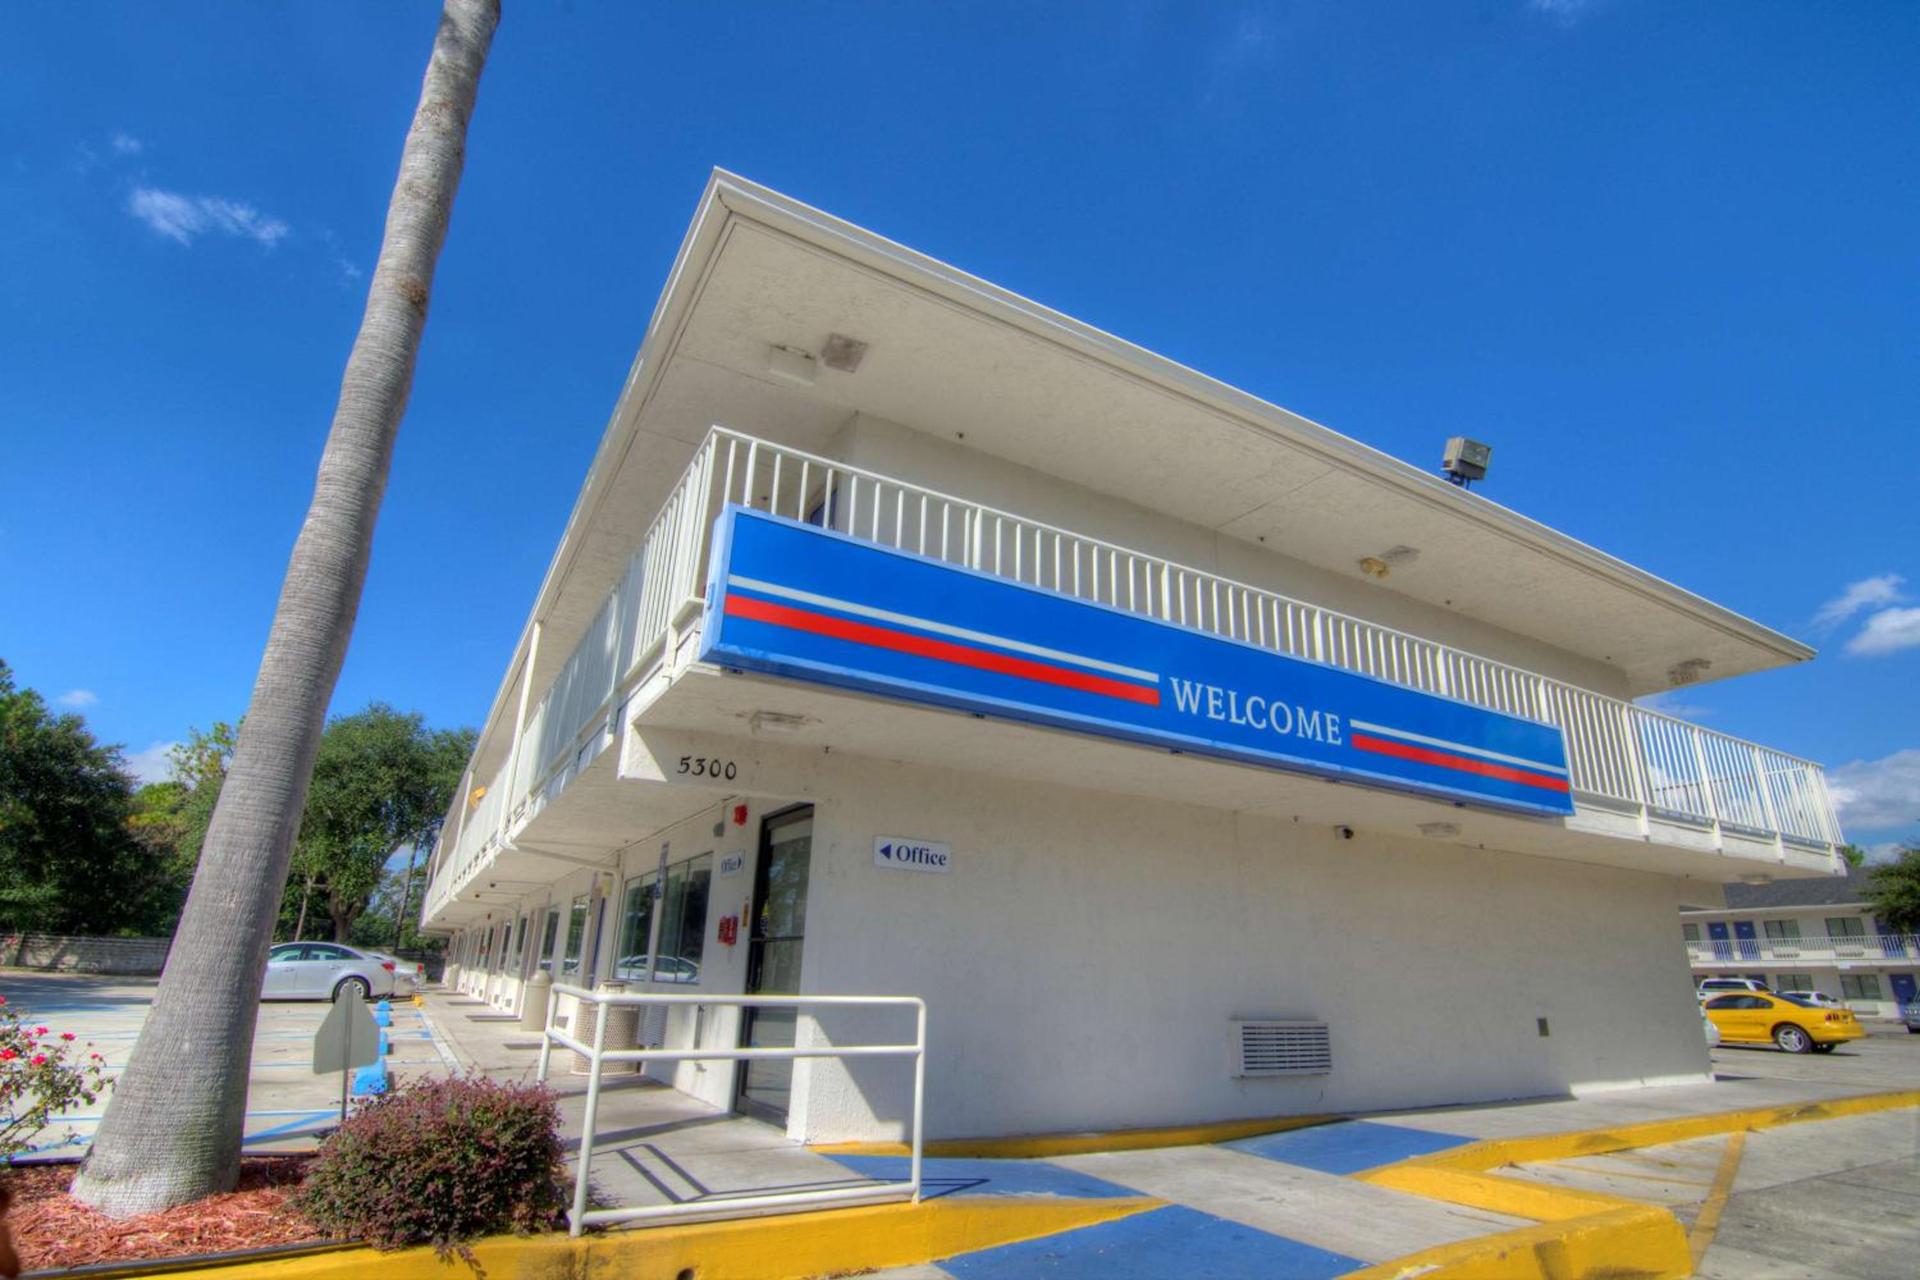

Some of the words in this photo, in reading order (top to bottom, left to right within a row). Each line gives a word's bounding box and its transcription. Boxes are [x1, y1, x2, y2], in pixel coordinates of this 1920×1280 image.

[1169, 676, 1342, 745] WELCOME
[677, 756, 737, 780] 5300
[896, 844, 947, 866] Office
